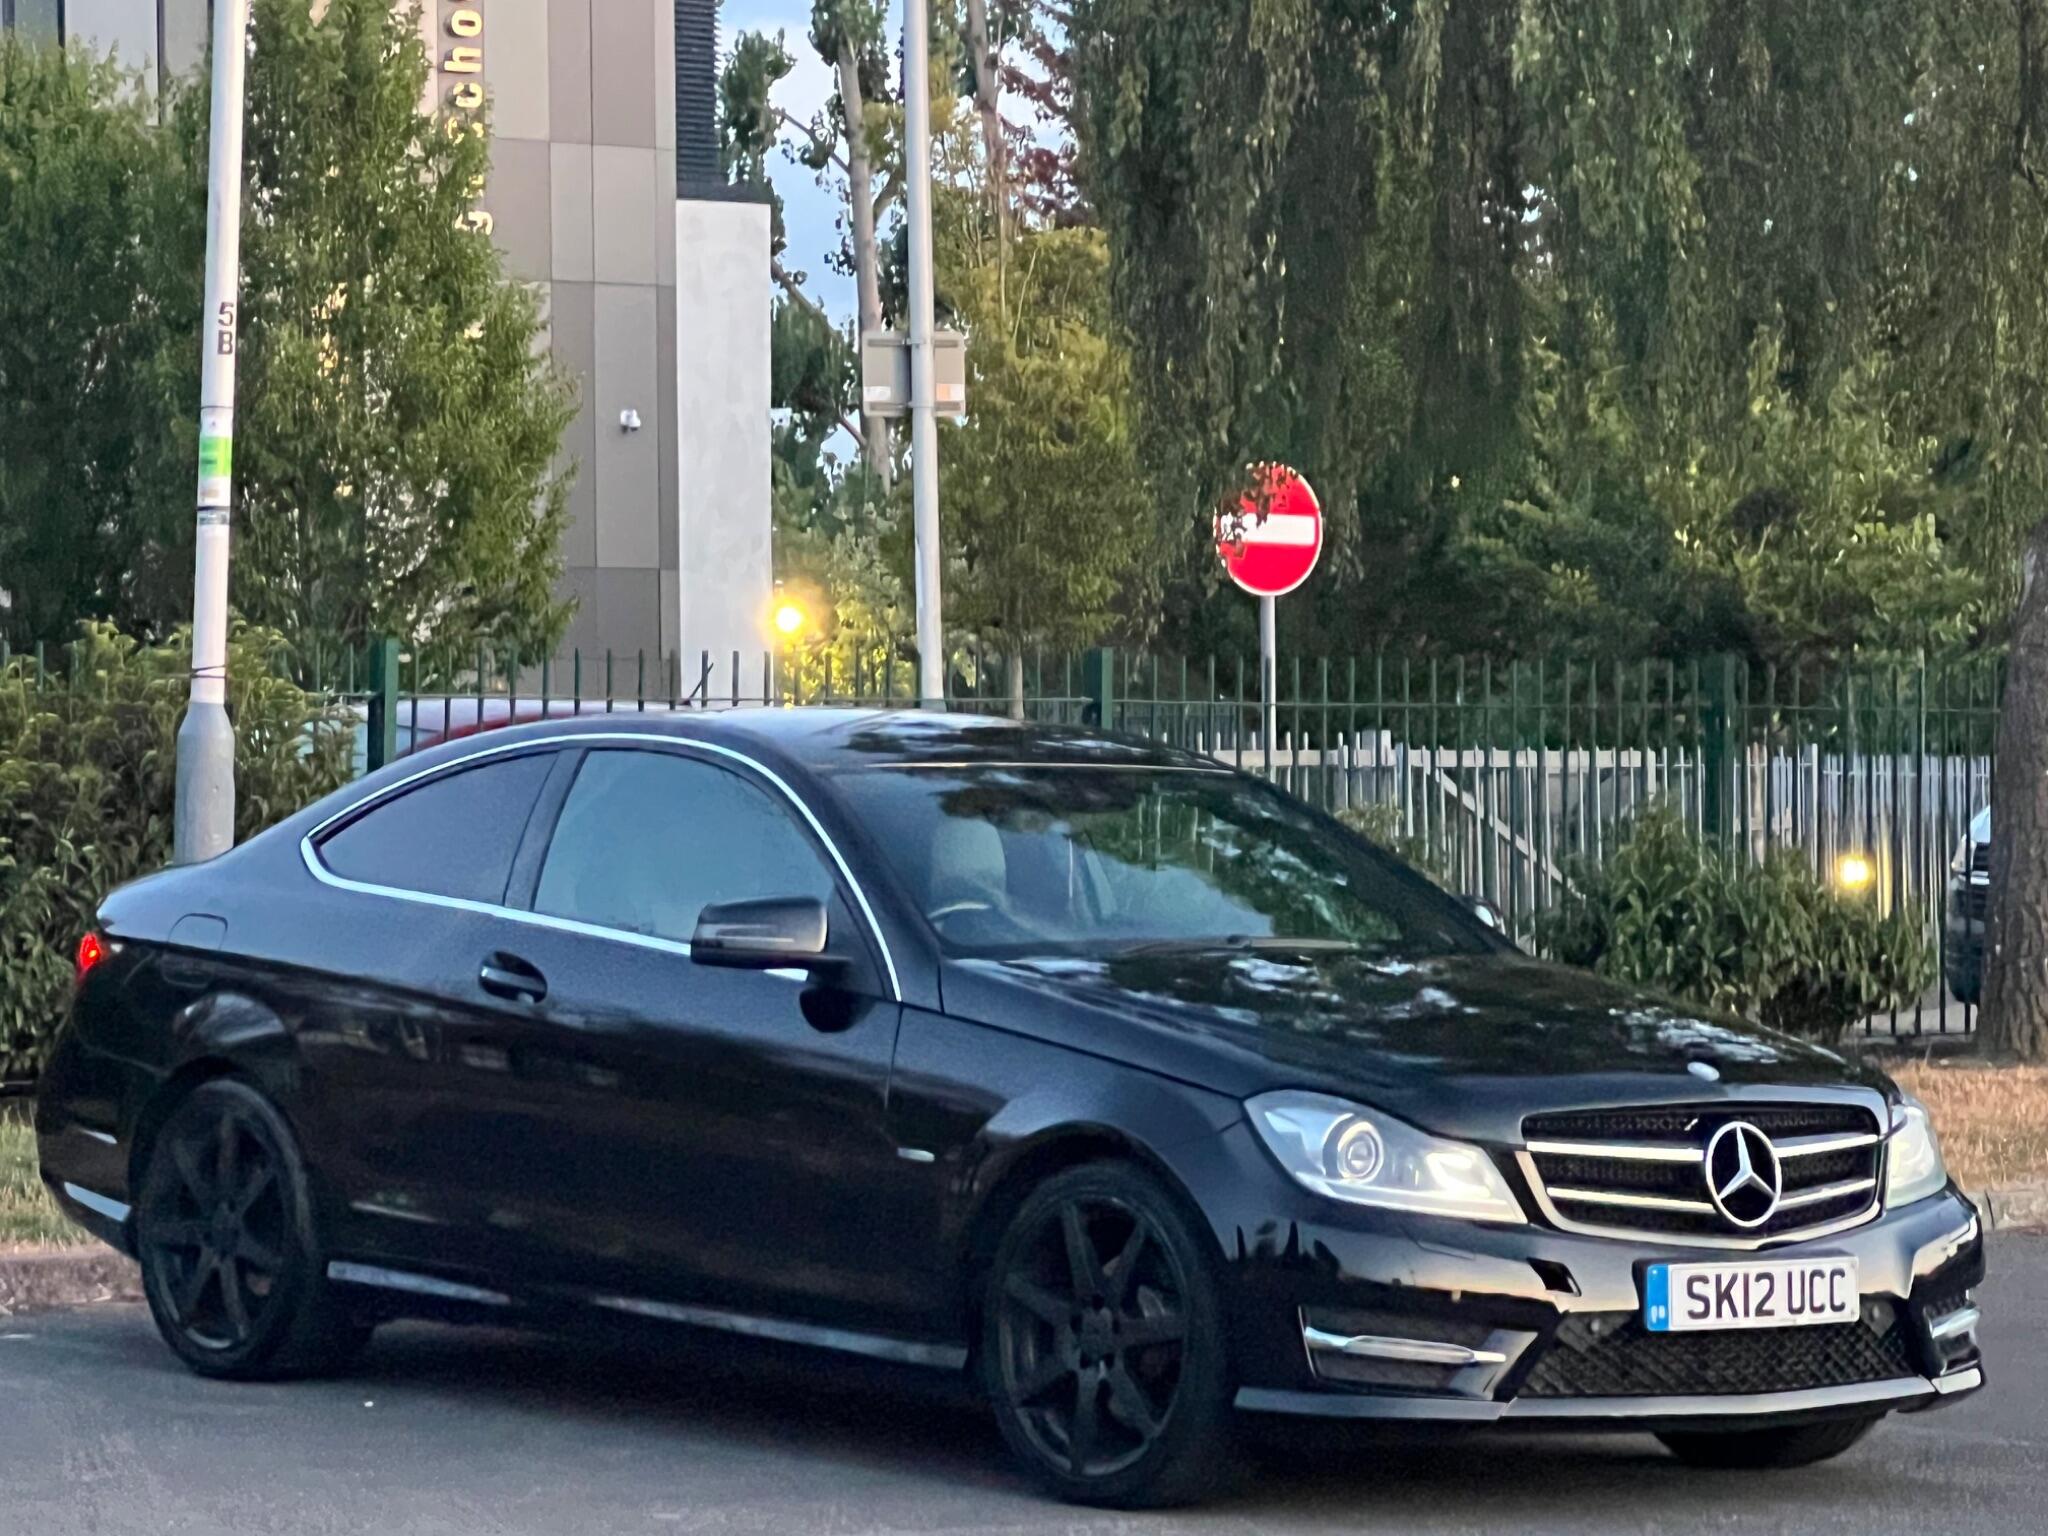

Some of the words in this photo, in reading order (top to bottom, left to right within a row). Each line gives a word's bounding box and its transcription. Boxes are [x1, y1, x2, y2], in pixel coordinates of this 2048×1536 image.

[218, 302, 235, 327] 5
[217, 329, 234, 355] B
[1686, 1271, 1776, 1320] SK12
[1787, 1267, 1846, 1315] UCC
